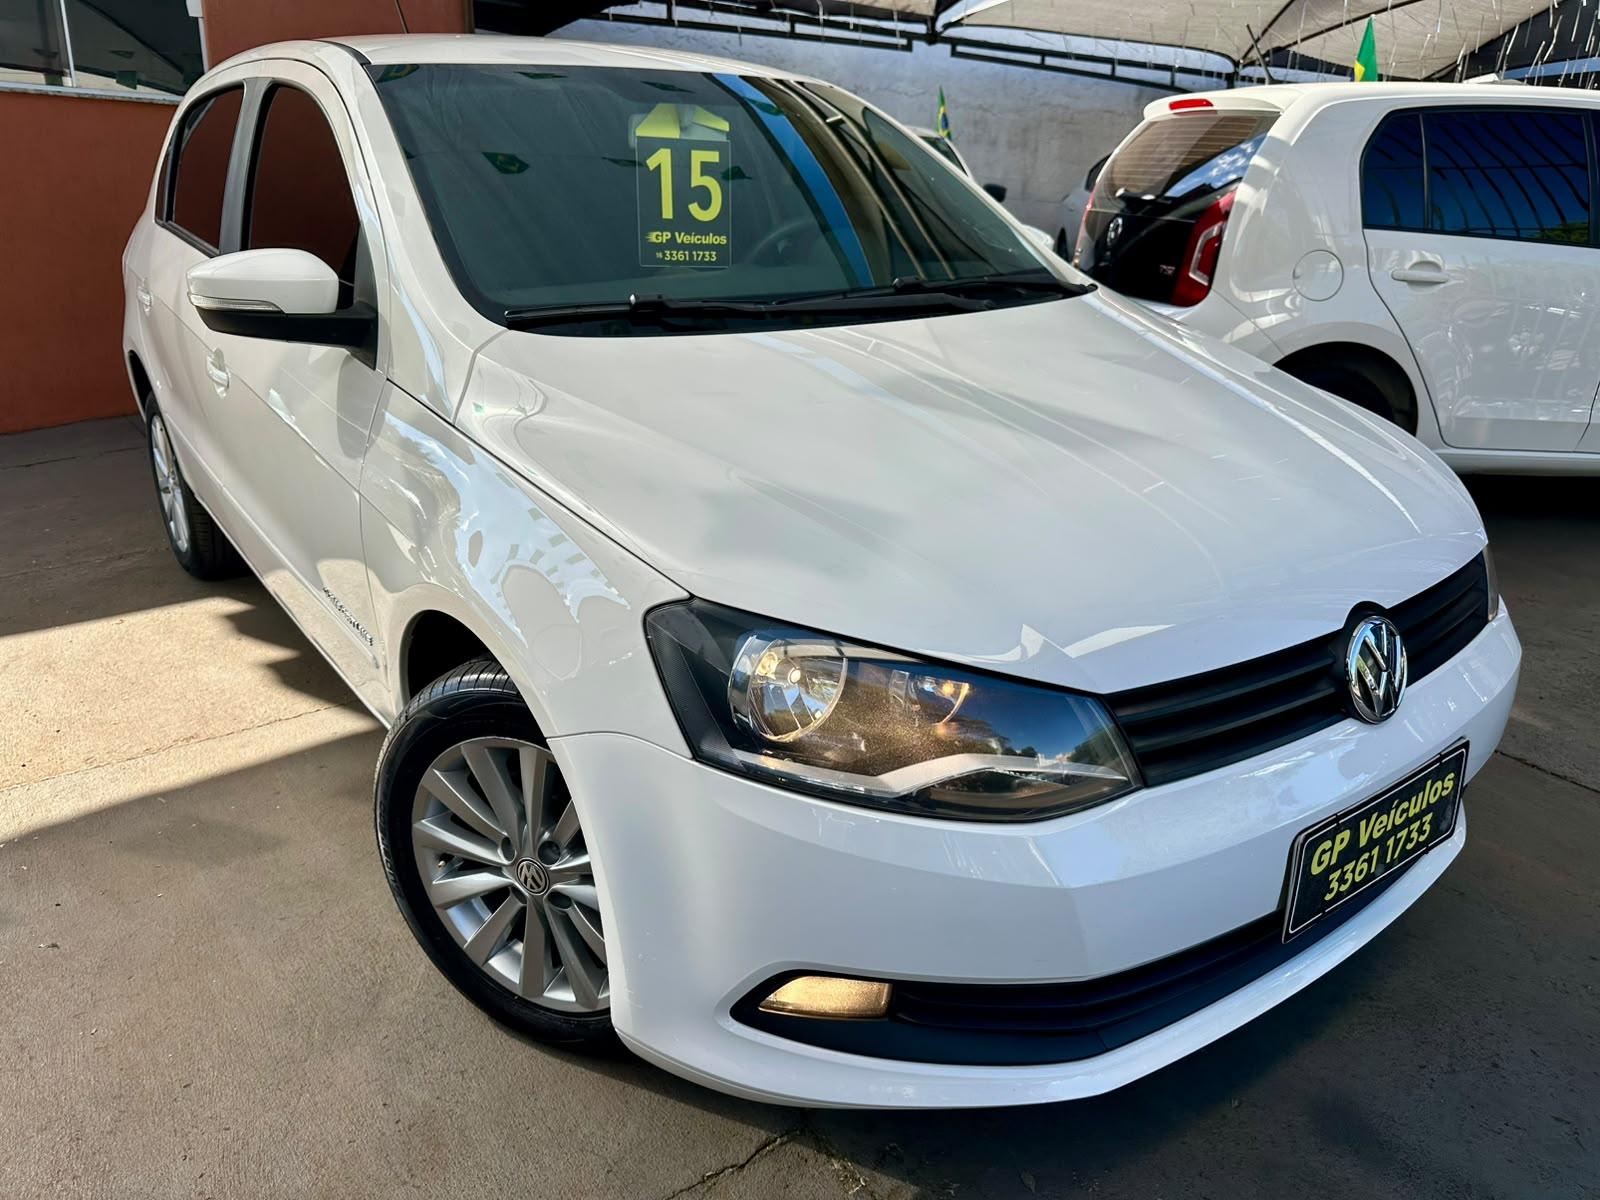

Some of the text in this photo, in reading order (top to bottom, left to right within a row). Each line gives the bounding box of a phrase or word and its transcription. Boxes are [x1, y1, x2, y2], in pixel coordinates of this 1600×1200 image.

[646, 147, 723, 222] 15
[650, 231, 727, 245] GP Veículos
[664, 250, 690, 261] 3361
[692, 251, 717, 262] 1733
[1310, 772, 1456, 876] GP Veículos
[1324, 812, 1434, 901] 3361 1733
